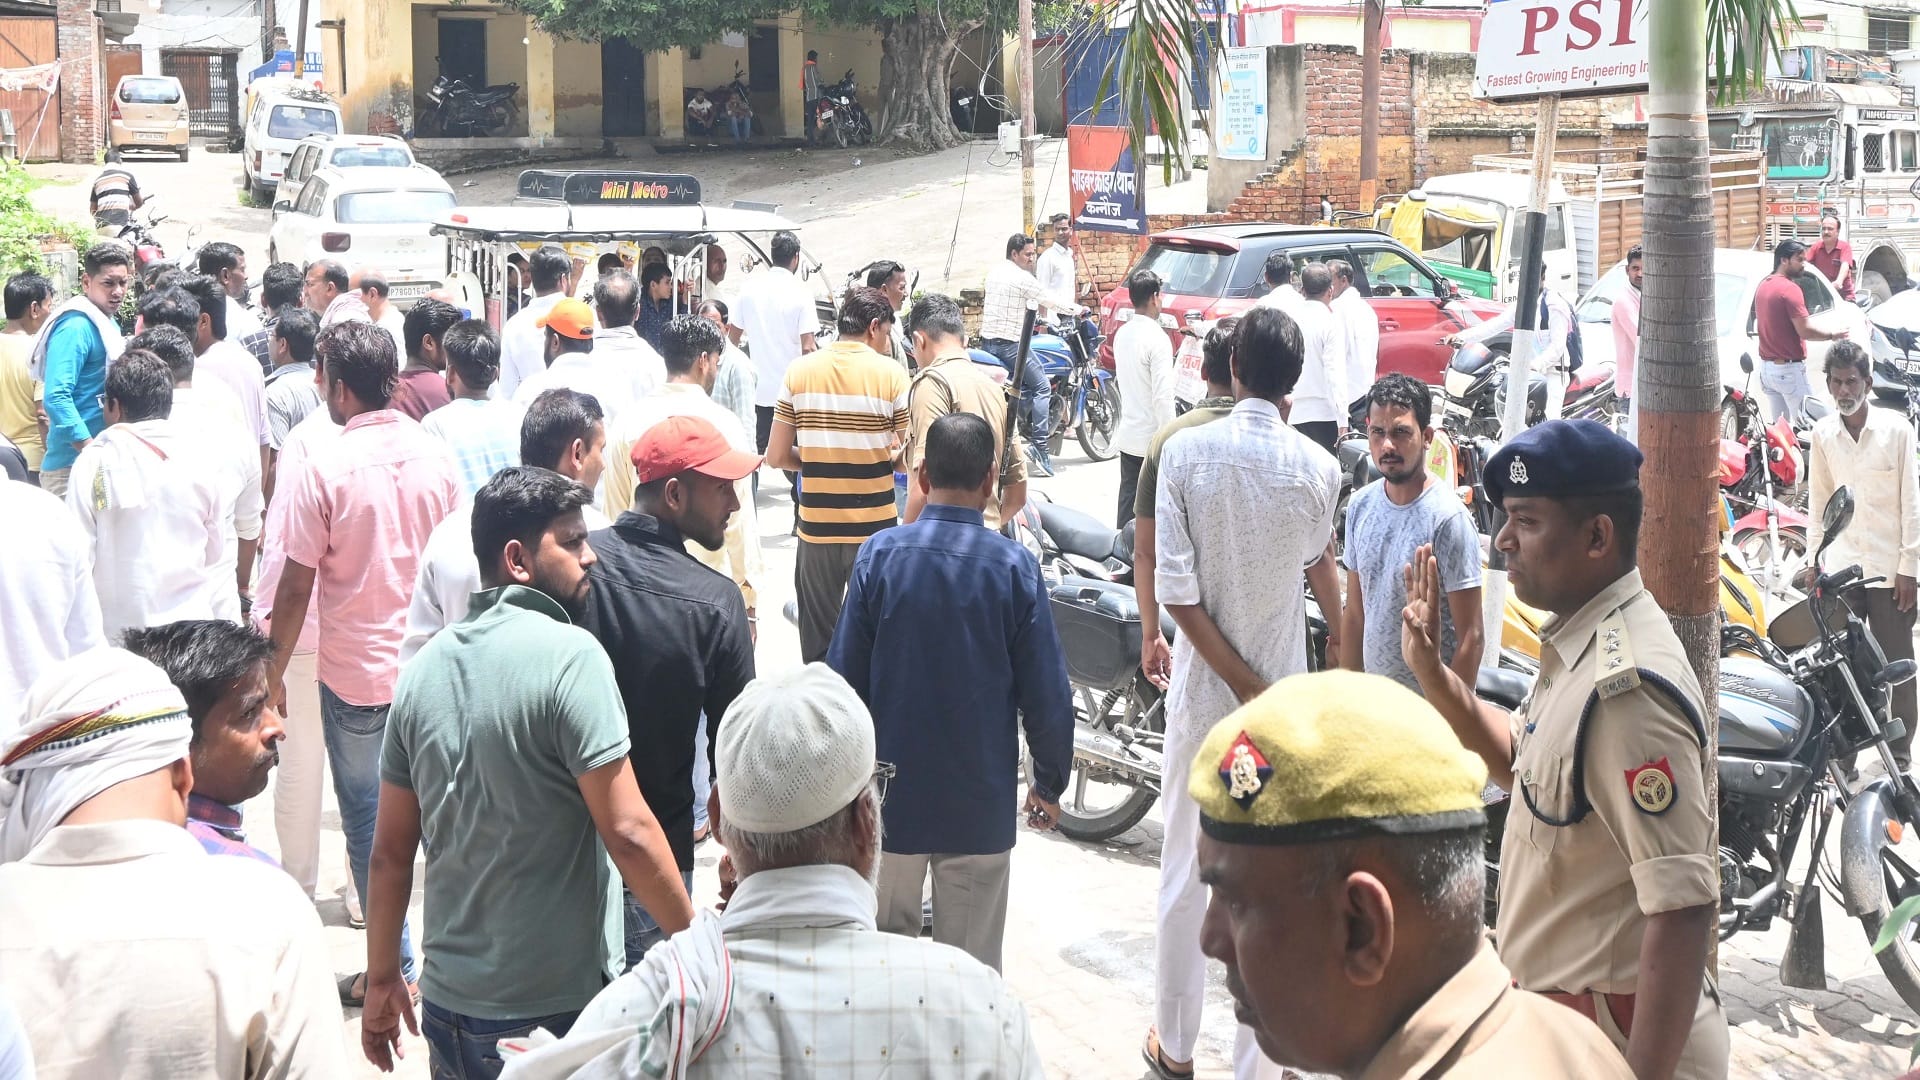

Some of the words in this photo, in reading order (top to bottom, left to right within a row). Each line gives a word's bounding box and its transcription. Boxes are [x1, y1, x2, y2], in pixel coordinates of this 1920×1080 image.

[1486, 71, 1522, 87] Fastest
[1525, 69, 1568, 85] Growing
[1570, 63, 1635, 81] Engineering
[600, 181, 629, 199] Mini
[631, 181, 668, 199] Metro
